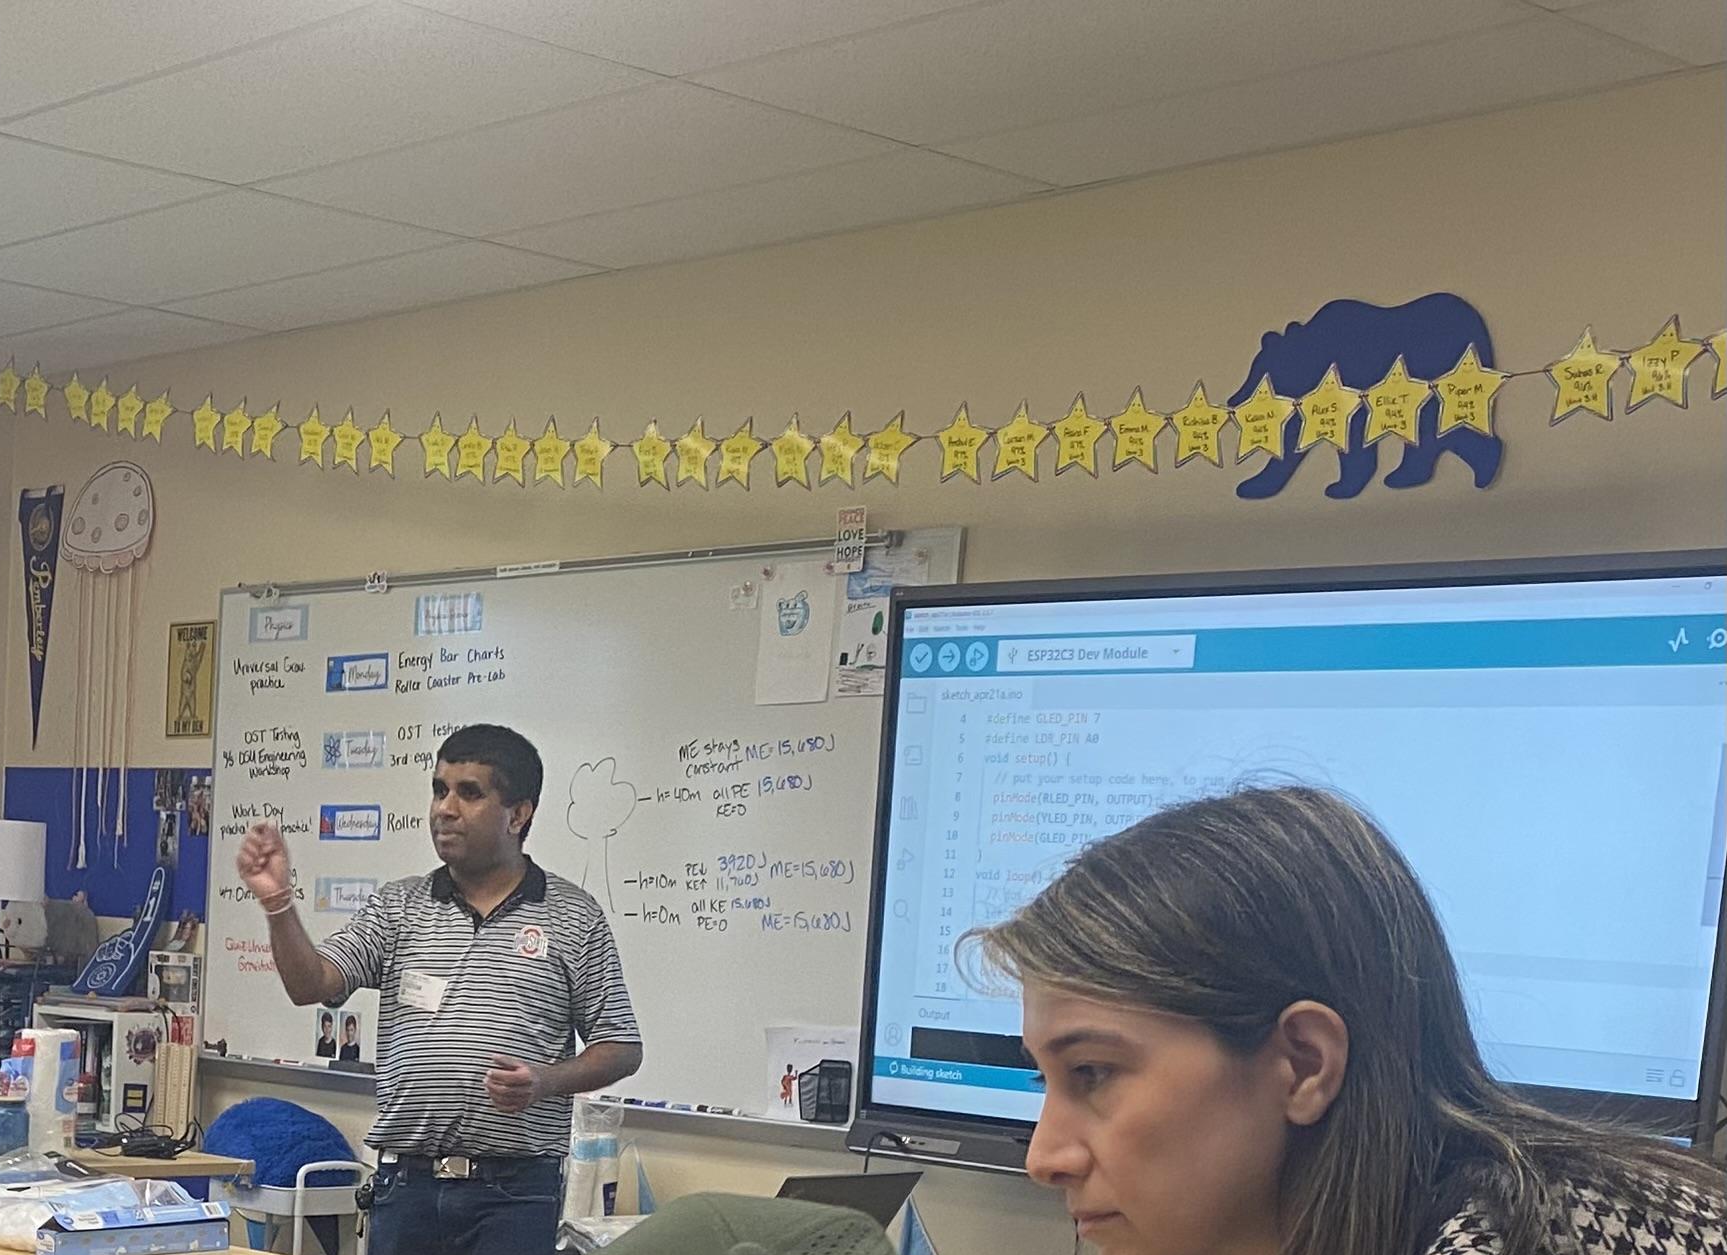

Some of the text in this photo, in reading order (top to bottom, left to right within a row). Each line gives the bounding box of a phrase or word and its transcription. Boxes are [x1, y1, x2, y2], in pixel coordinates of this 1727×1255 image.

[838, 528, 864, 542] LOVE
[837, 545, 863, 558] HOPE
[177, 626, 208, 641] WELCOME
[398, 646, 505, 672] Energy Bar Charts
[1027, 646, 1149, 662] ESP32C3 Dev Module
[347, 665, 381, 685] Monday
[395, 678, 421, 695] Roller
[427, 675, 462, 690] Coaster
[941, 687, 1023, 703] sketch_apr21a.ino
[986, 712, 1101, 726] #define GLED_PIN 7
[244, 729, 266, 744] OST
[397, 723, 422, 741] OST
[985, 733, 1100, 746] #define LDR_PIN A0
[258, 748, 307, 769] Engineering
[346, 739, 377, 764] Tuesday
[679, 739, 700, 762] ME
[703, 739, 741, 760] stays
[983, 752, 1058, 766] void setup()
[390, 752, 434, 772] 3rd egg
[685, 756, 743, 778] constant
[1012, 774, 1032, 786] put
[1037, 774, 1064, 786] your
[1070, 774, 1102, 787] setup
[1107, 774, 1136, 785] code
[1182, 775, 1197, 786] to
[731, 782, 751, 799] PE
[232, 803, 284, 822] Work Day
[716, 803, 747, 817] KE=0
[337, 814, 379, 836] Wednesday
[387, 812, 422, 832] Roller
[946, 830, 958, 841] 10
[639, 871, 677, 890] h=10m
[943, 868, 1000, 880] 12 void
[691, 899, 706, 914] all
[710, 900, 728, 914] KE
[643, 902, 680, 925] h=0m
[697, 917, 728, 932] PE=0
[918, 1008, 950, 1021] Output
[901, 1064, 963, 1081] Building sketch
